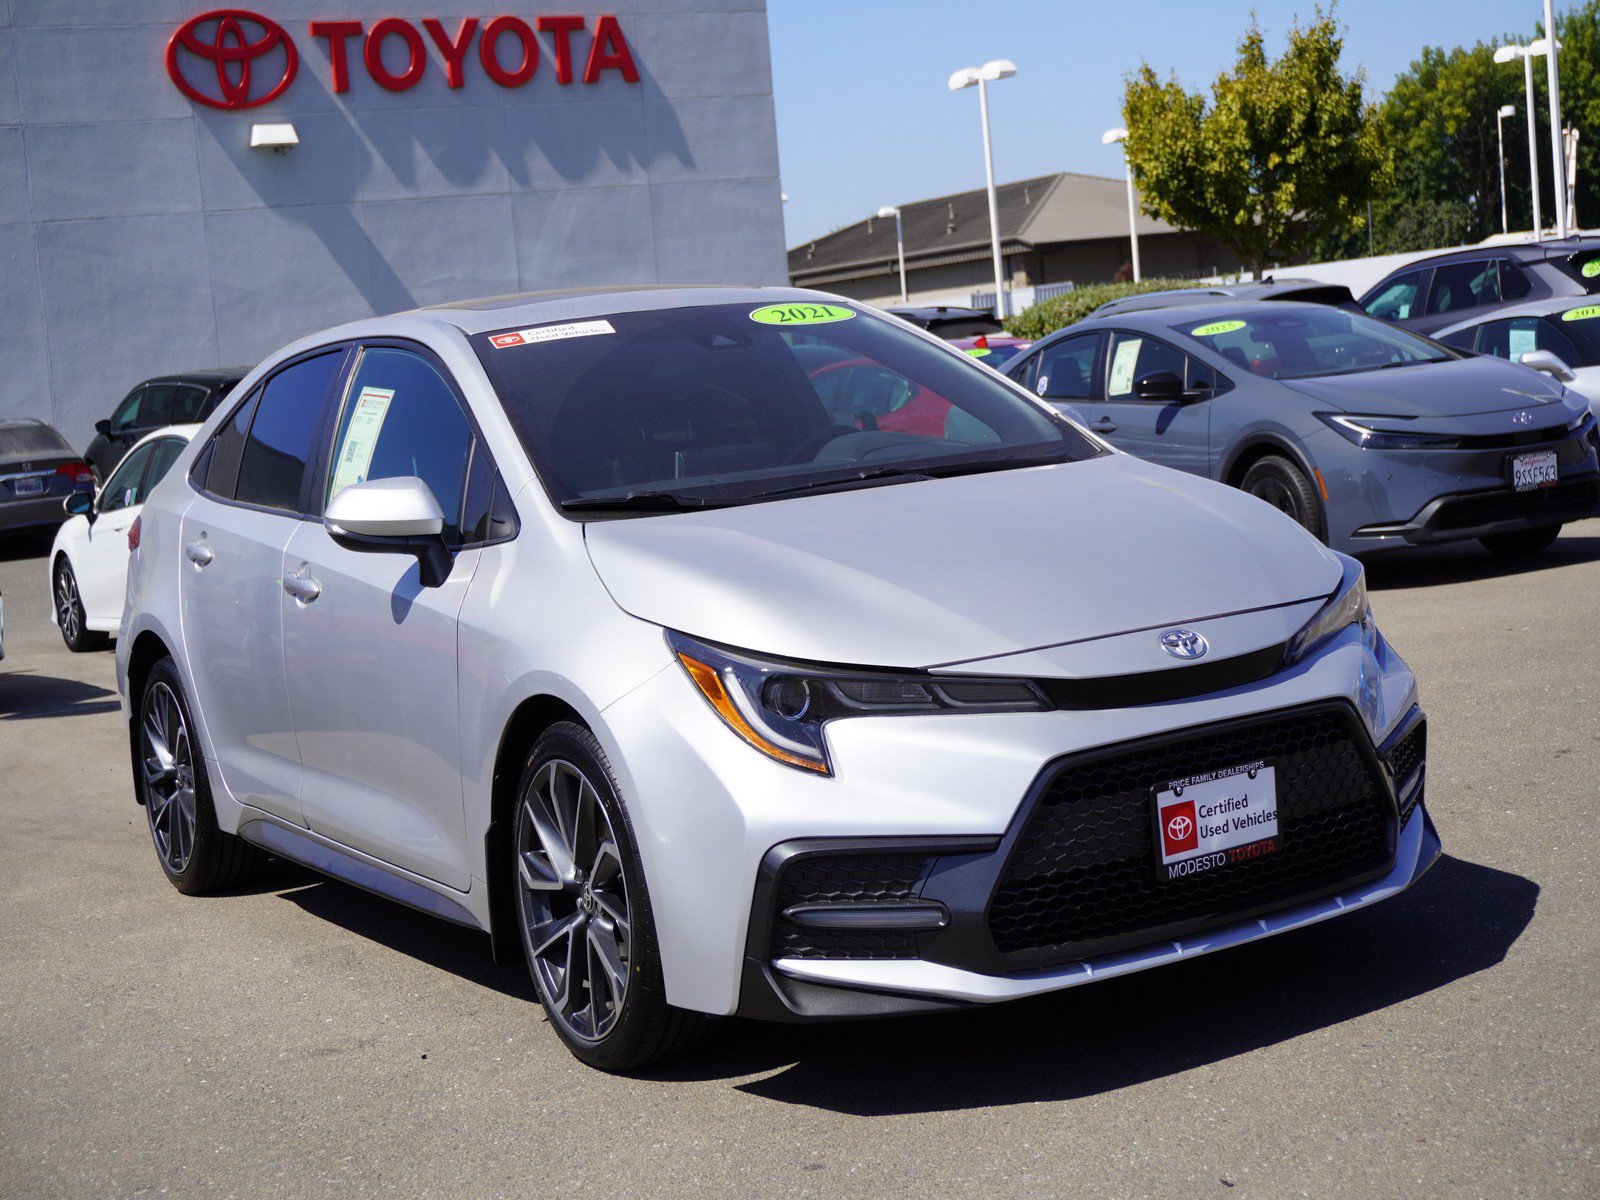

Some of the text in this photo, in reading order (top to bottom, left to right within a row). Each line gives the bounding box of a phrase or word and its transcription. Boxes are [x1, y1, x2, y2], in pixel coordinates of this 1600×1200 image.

[309, 15, 641, 93] TOYOTA
[771, 306, 835, 323] 2021
[528, 326, 574, 335] Certified
[562, 328, 606, 336] Vehicles
[1169, 761, 1265, 790] PRICE FAMILY DEALERSHIPS
[1198, 794, 1249, 818] Certified
[1200, 810, 1278, 839] Used Vehicles
[1168, 839, 1276, 879] MODESTO TOYOTA
